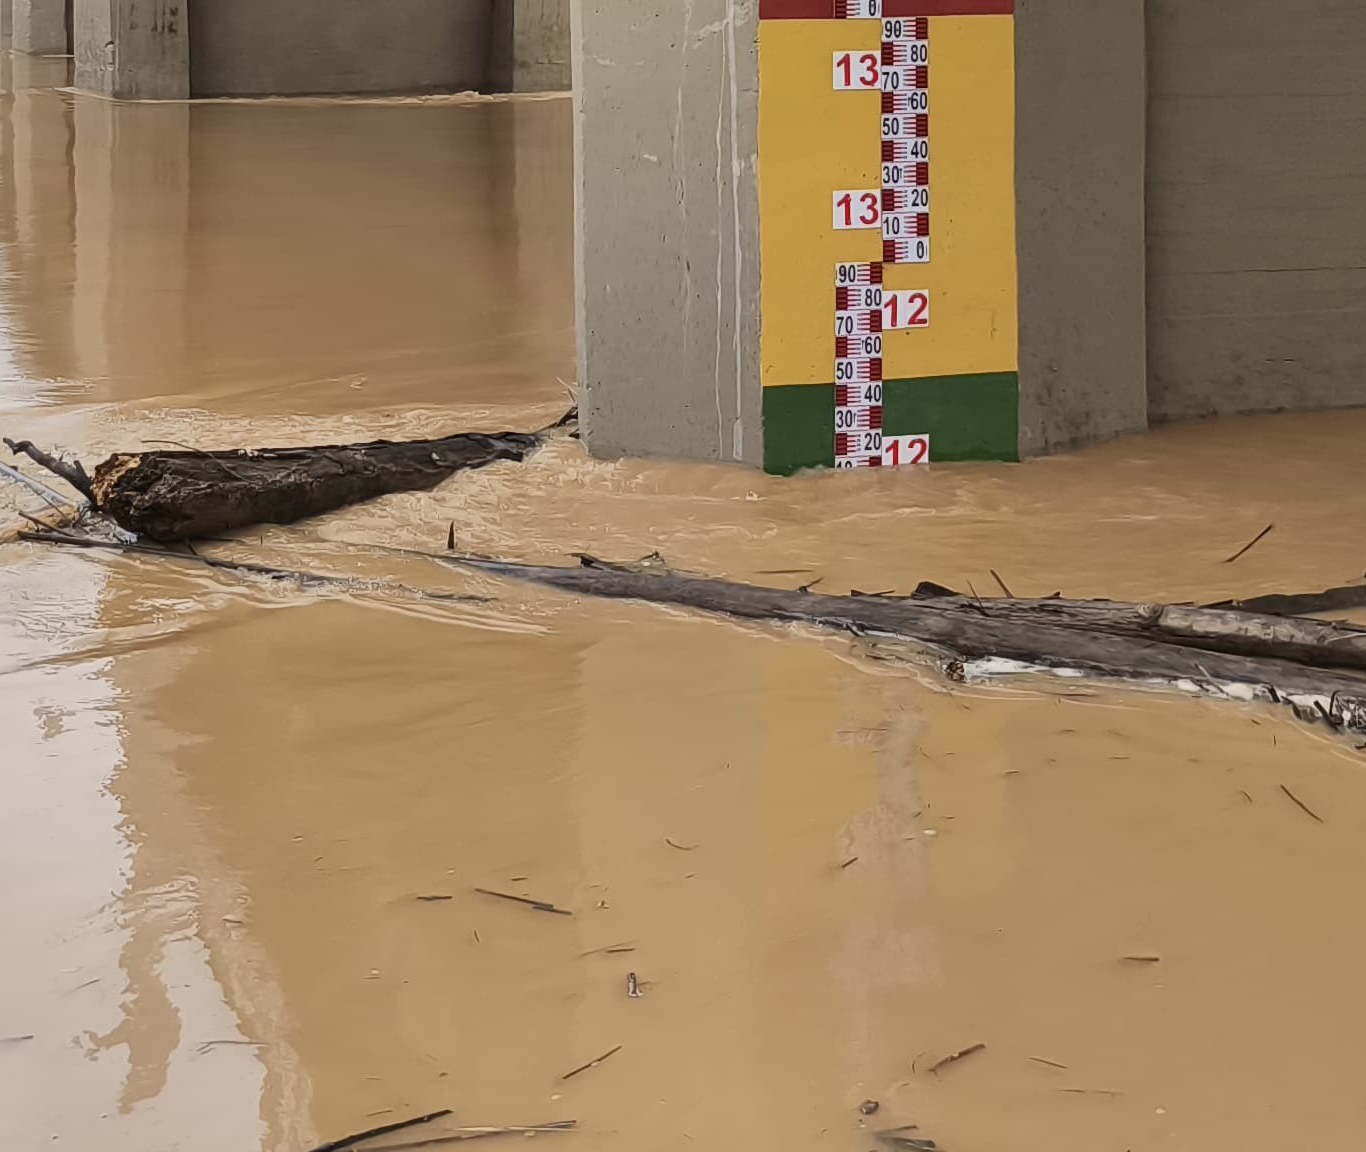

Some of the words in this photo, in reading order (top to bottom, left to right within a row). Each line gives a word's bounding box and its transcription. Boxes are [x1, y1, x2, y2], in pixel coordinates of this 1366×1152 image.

[868, 0, 876, 17] 0
[884, 20, 901, 38] 90
[910, 45, 927, 63] 80
[836, 54, 879, 86] 13
[883, 72, 899, 90] 70
[911, 92, 928, 110] 60
[883, 118, 899, 136] 50
[910, 141, 928, 159] 40
[883, 165, 900, 184] 30
[911, 189, 928, 207] 20
[837, 193, 879, 225] 13
[883, 216, 900, 235] 10
[916, 241, 924, 259] 0
[838, 264, 856, 283] 90
[865, 289, 882, 307] 80
[884, 294, 927, 326] 12
[837, 316, 853, 334] 70
[865, 336, 882, 354] 60
[836, 362, 853, 380] 50
[865, 385, 882, 403] 40
[836, 410, 853, 428] 30
[865, 433, 882, 451] 20
